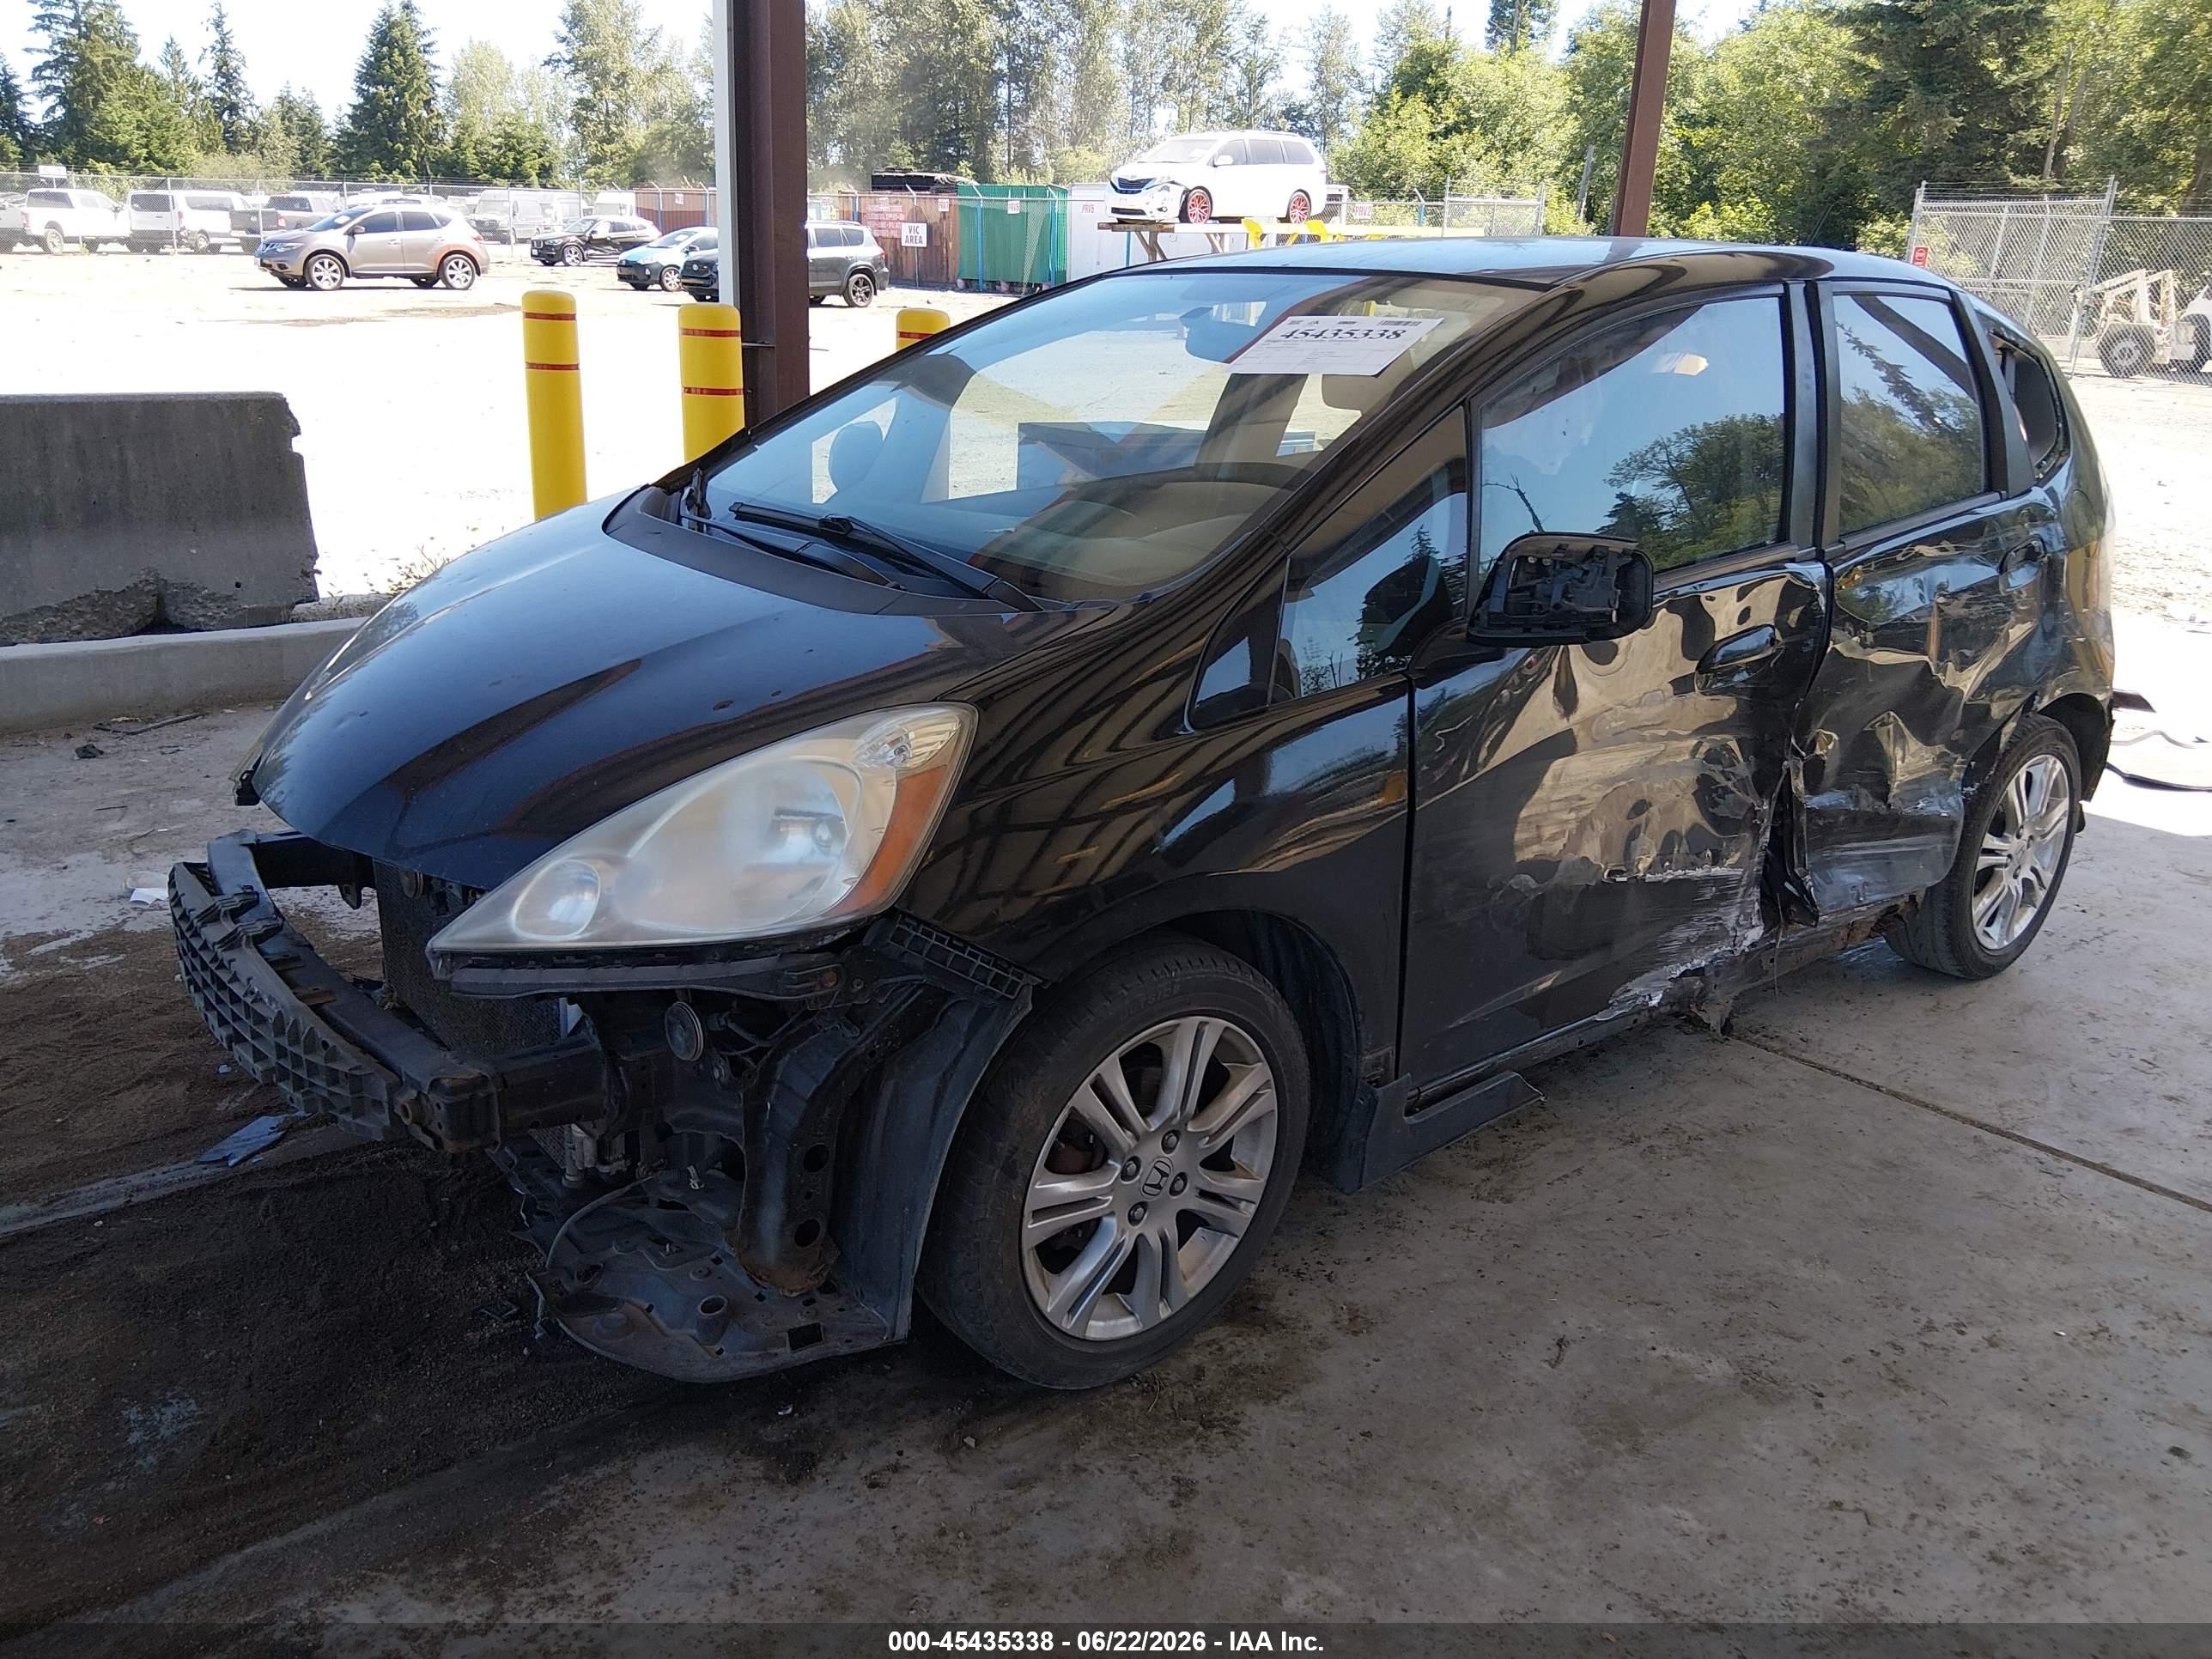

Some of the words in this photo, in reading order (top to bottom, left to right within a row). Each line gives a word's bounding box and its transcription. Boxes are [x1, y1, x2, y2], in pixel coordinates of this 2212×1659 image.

[908, 225, 920, 234] VIC
[904, 236, 923, 245] AREA
[1280, 329, 1407, 340] 45435338
